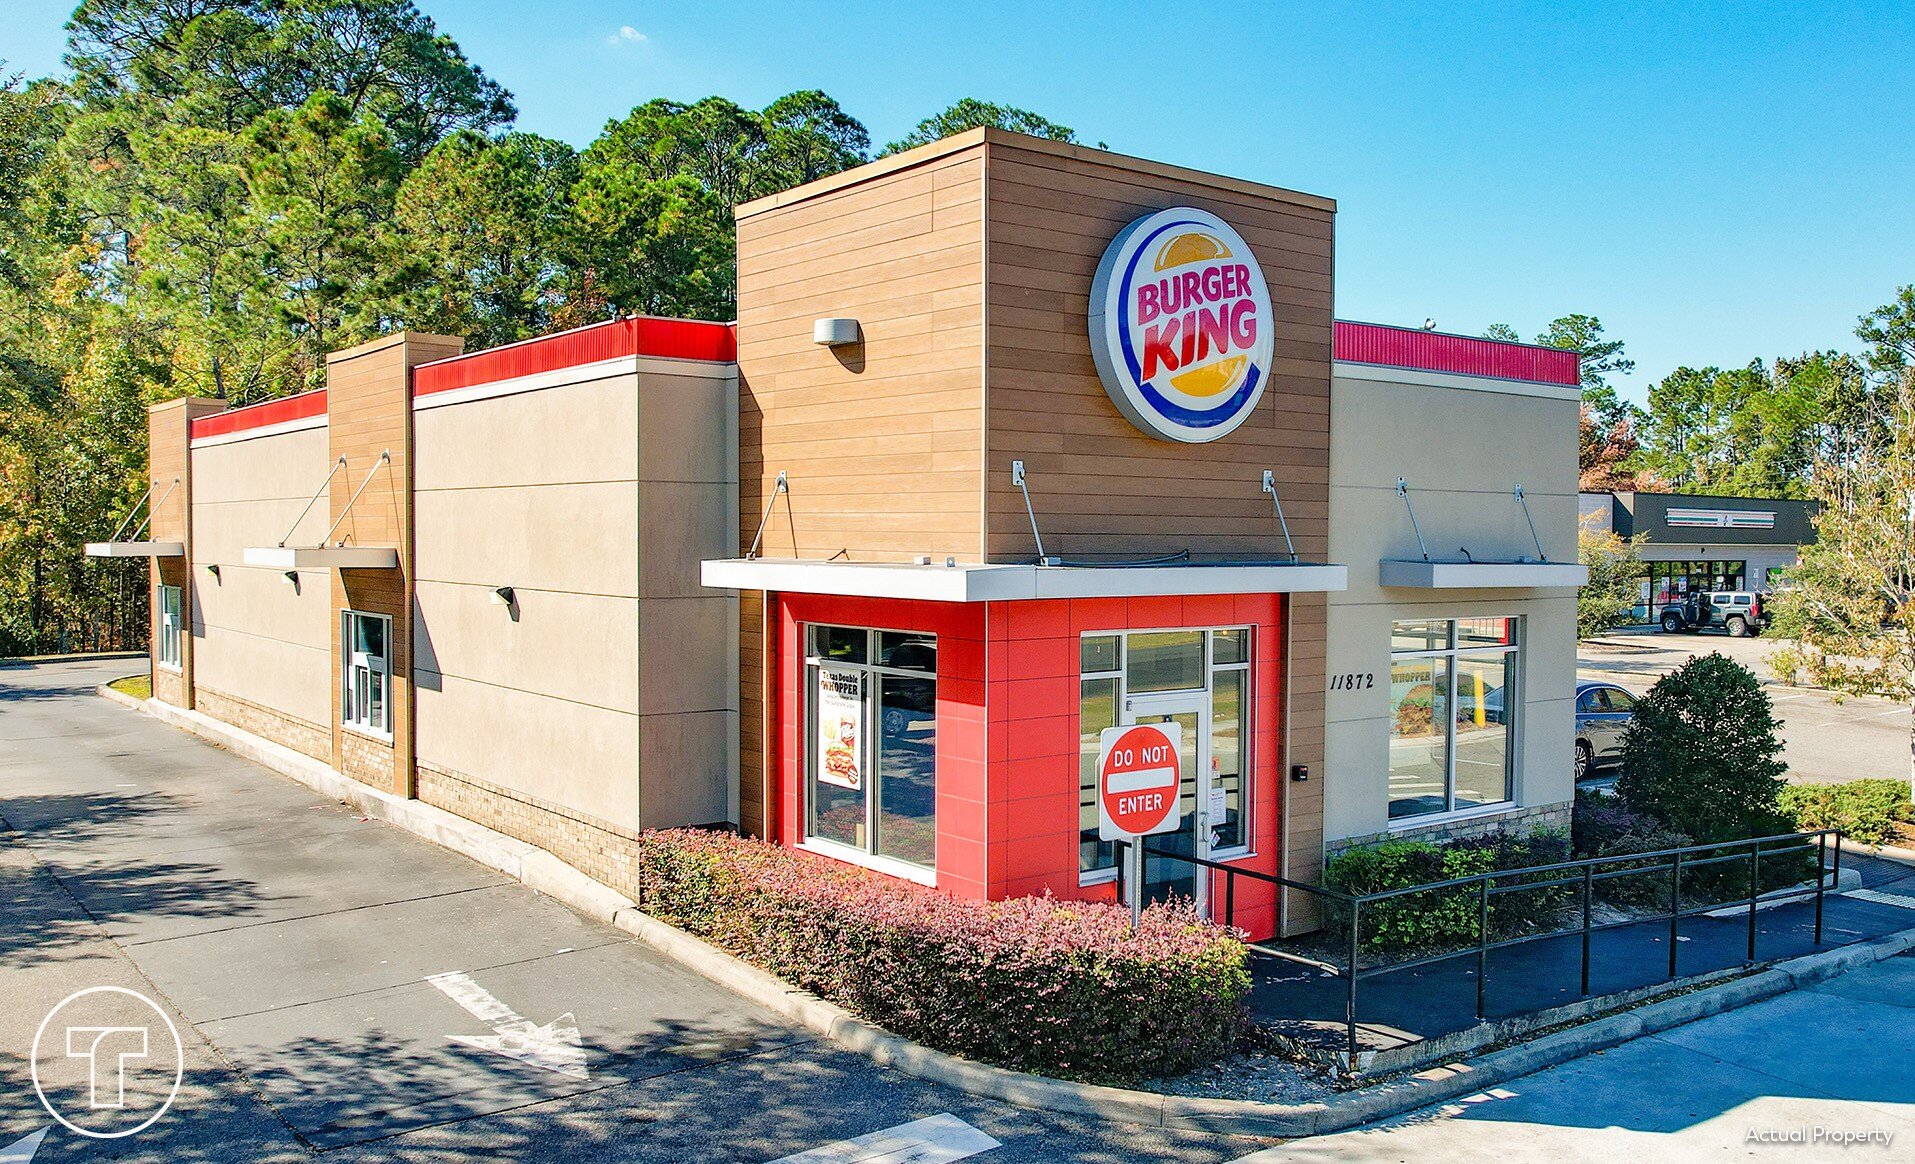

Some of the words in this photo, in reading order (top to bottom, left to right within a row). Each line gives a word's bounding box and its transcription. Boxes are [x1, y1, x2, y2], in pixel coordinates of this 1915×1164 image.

[1138, 264, 1252, 326] BURGER
[1142, 299, 1256, 382] KING
[821, 680, 858, 695] WHOPPER
[839, 673, 858, 684] Double
[1330, 673, 1374, 690] 11872
[1391, 672, 1431, 684] WHOPPER
[1114, 749, 1133, 767] DO
[1142, 745, 1169, 764] NOT
[1119, 793, 1163, 815] ENTER
